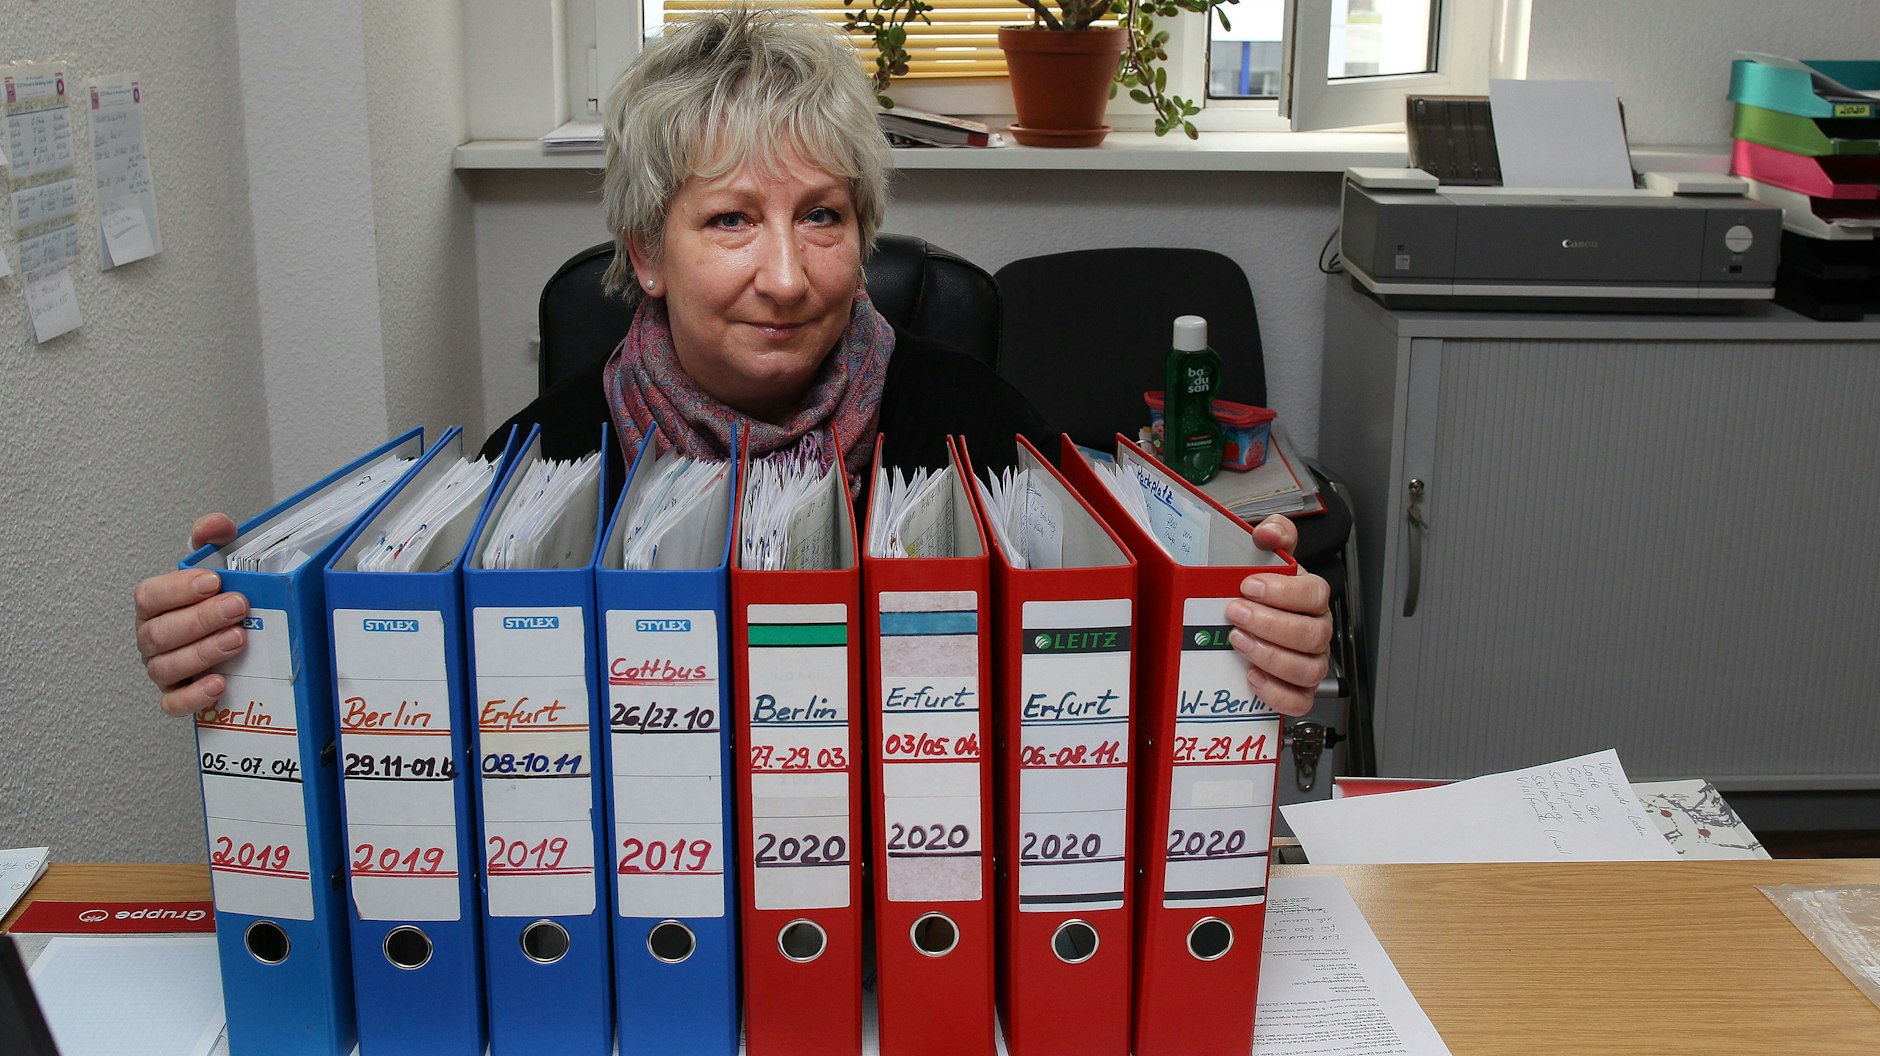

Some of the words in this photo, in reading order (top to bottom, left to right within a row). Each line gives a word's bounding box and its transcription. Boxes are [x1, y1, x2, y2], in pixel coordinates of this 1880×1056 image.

[1561, 239, 1598, 248] Canon
[365, 620, 415, 631] STYLEX
[505, 618, 556, 628] STYLEX
[638, 620, 688, 631] STYLEX
[1054, 631, 1119, 649] LEITZ
[610, 658, 706, 681] Cottbus
[753, 694, 837, 721] Berlin
[886, 686, 975, 708] Erfurt
[1023, 689, 1119, 719] Erfurt
[199, 698, 272, 725] Berlin
[342, 697, 431, 728] Berlin
[479, 697, 566, 731] Erfurt
[755, 833, 846, 864] 2020
[887, 823, 970, 850] 2020
[1021, 832, 1101, 860] 2020
[1168, 830, 1246, 856] 2020
[213, 836, 290, 871] 2019
[352, 843, 444, 873] 2019
[488, 836, 569, 869] 2019
[618, 838, 712, 872] 2019
[115, 909, 206, 921] Gruppe
